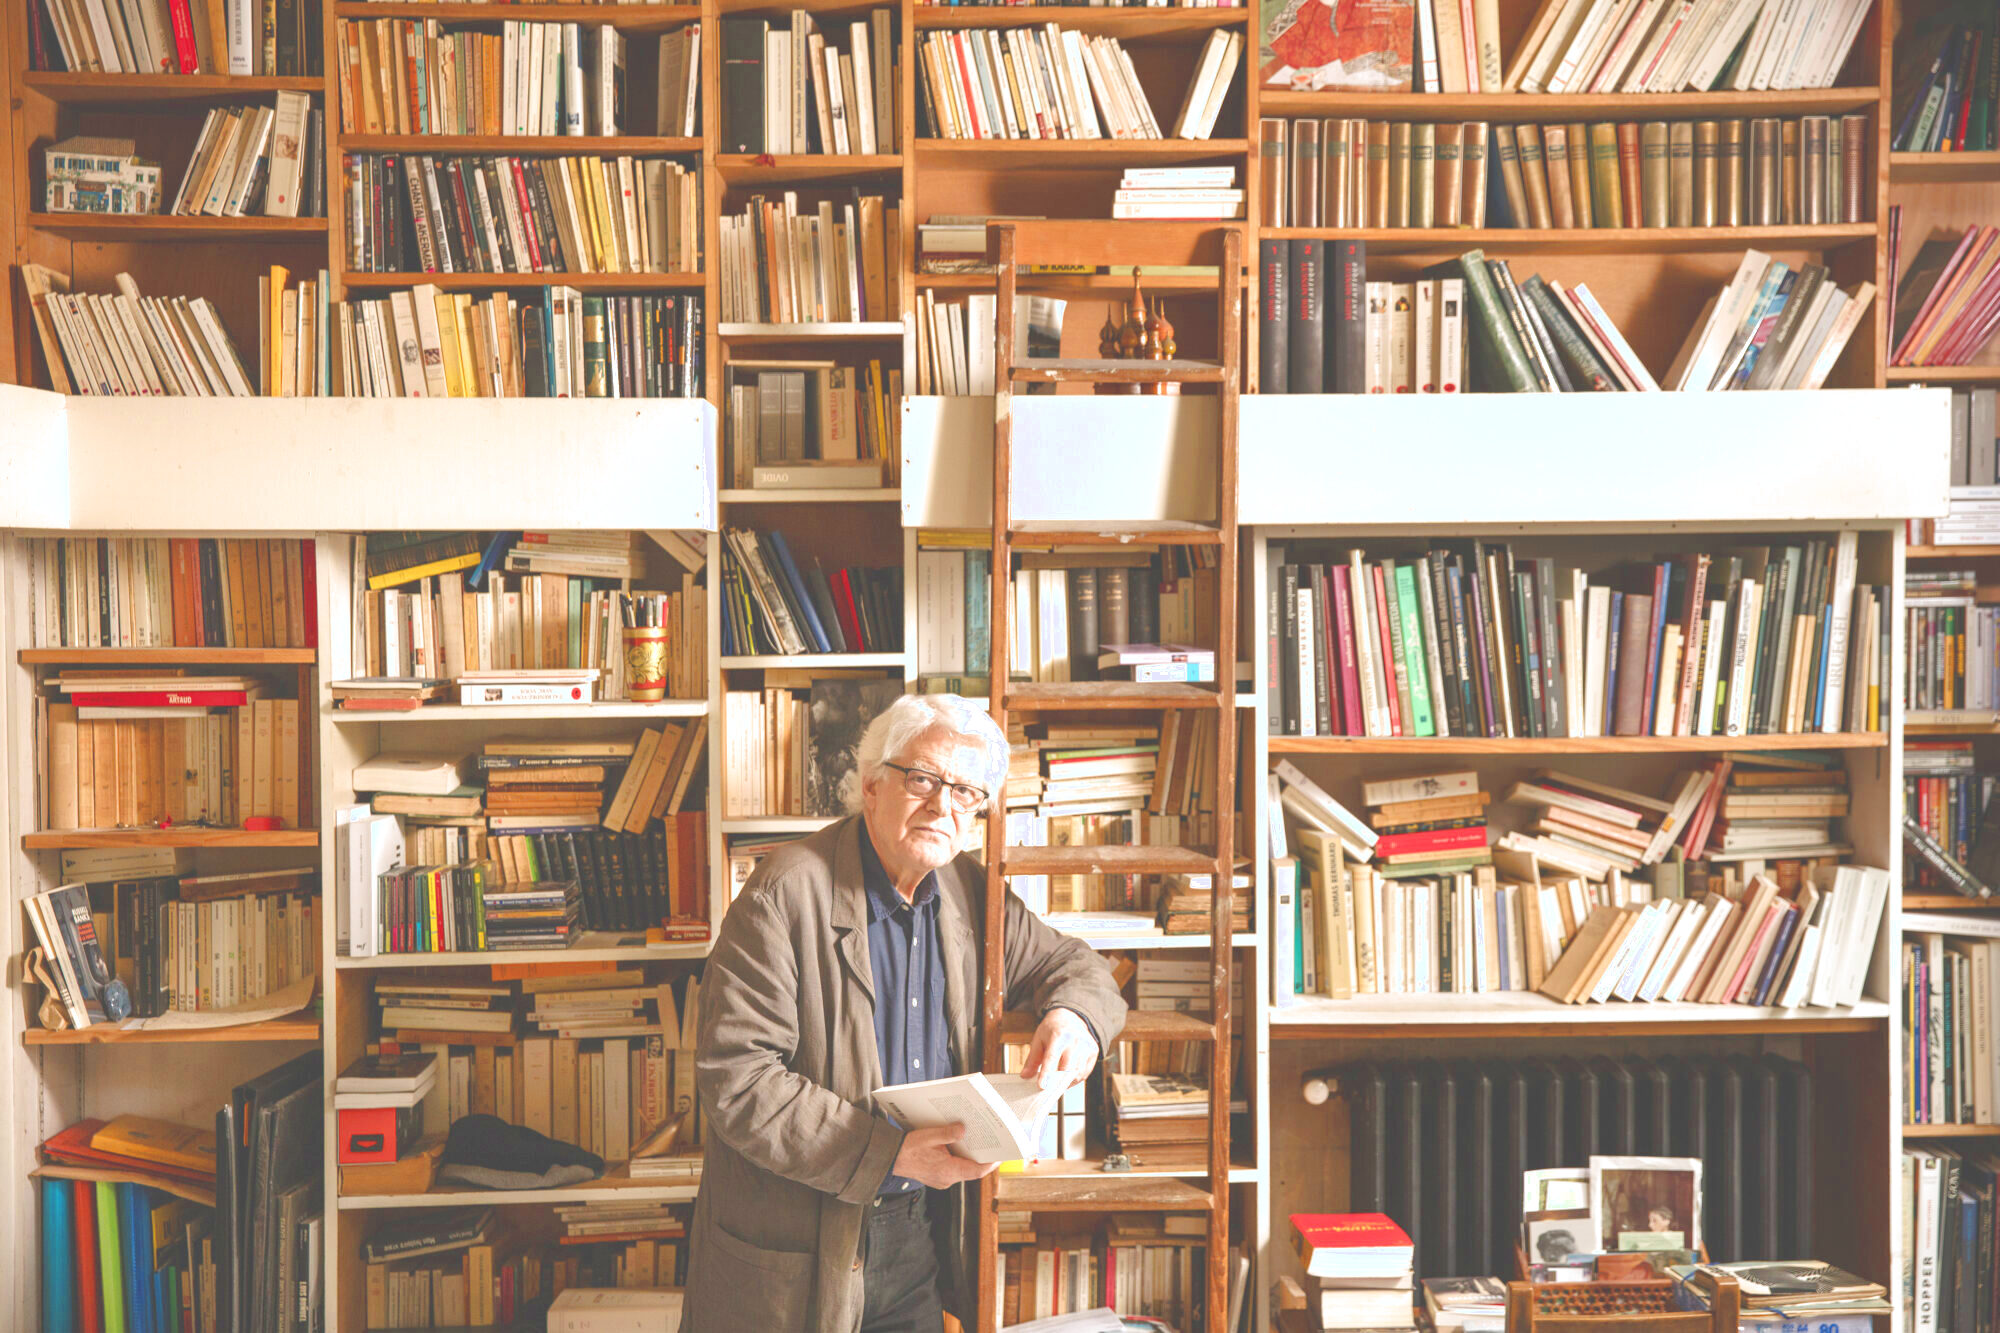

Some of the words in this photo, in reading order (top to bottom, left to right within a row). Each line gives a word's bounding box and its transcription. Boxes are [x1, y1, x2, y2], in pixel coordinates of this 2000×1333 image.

[410, 178, 426, 221] CHANTAL
[418, 223, 433, 272] AKERMAN
[760, 473, 789, 482] OVIDE
[1286, 575, 1297, 620] Rembrandt
[1828, 611, 1849, 688] BRUEGEL
[169, 696, 192, 705] ARTAUD
[1328, 842, 1339, 883] BERNHARD
[1330, 884, 1341, 917] THOMAS
[1920, 1256, 1933, 1325] HOPPER
